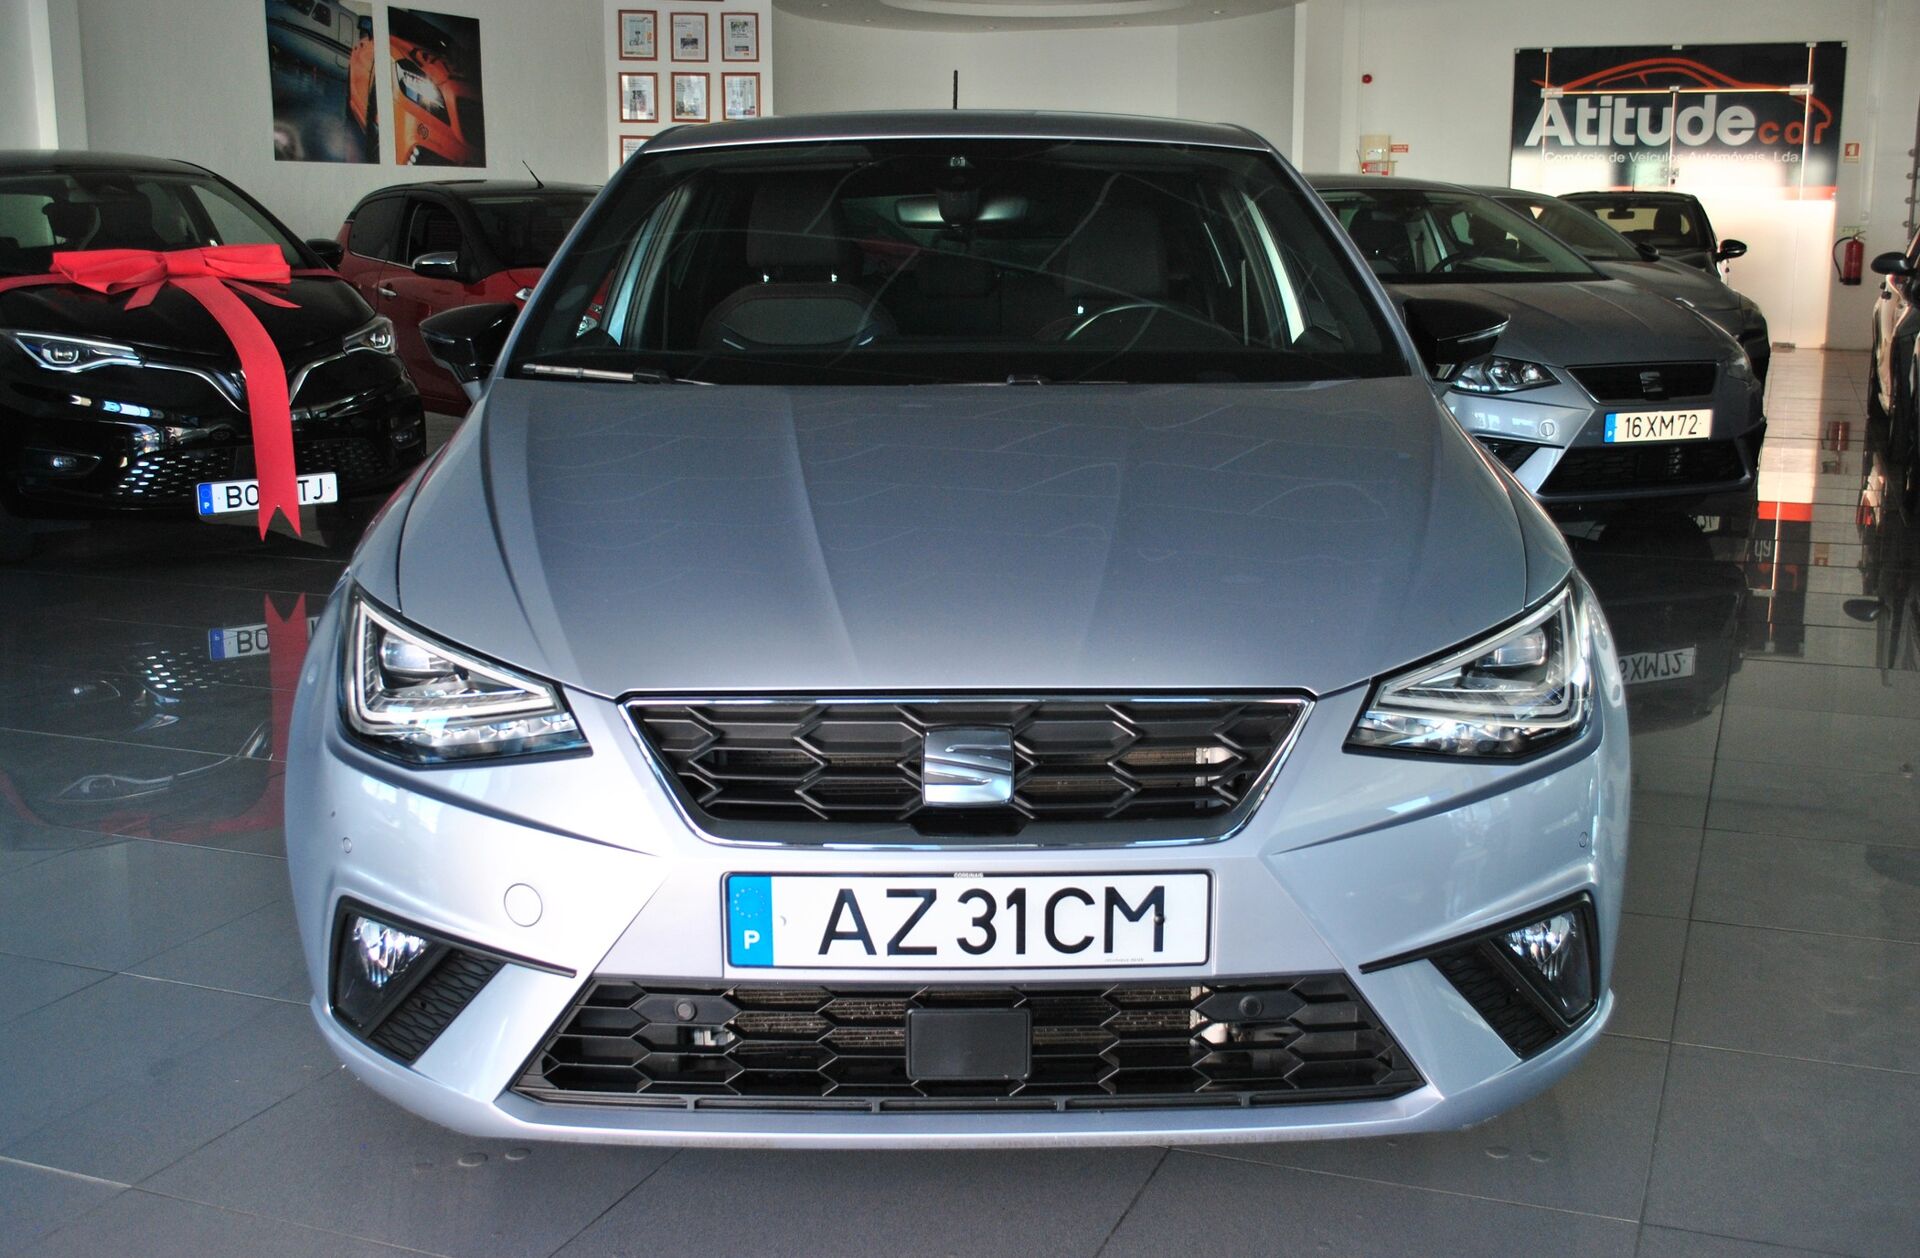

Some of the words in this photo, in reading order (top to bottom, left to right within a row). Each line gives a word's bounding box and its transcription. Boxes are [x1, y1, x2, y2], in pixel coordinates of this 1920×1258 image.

[1609, 152, 1625, 163] de
[1625, 417, 1642, 438] 16
[1645, 415, 1675, 437] XM
[1678, 414, 1698, 436] 72
[297, 478, 324, 501] TJ
[817, 887, 938, 956] AZ
[956, 886, 1027, 956] 31
[1044, 885, 1165, 955] CM
[744, 930, 760, 950] P
